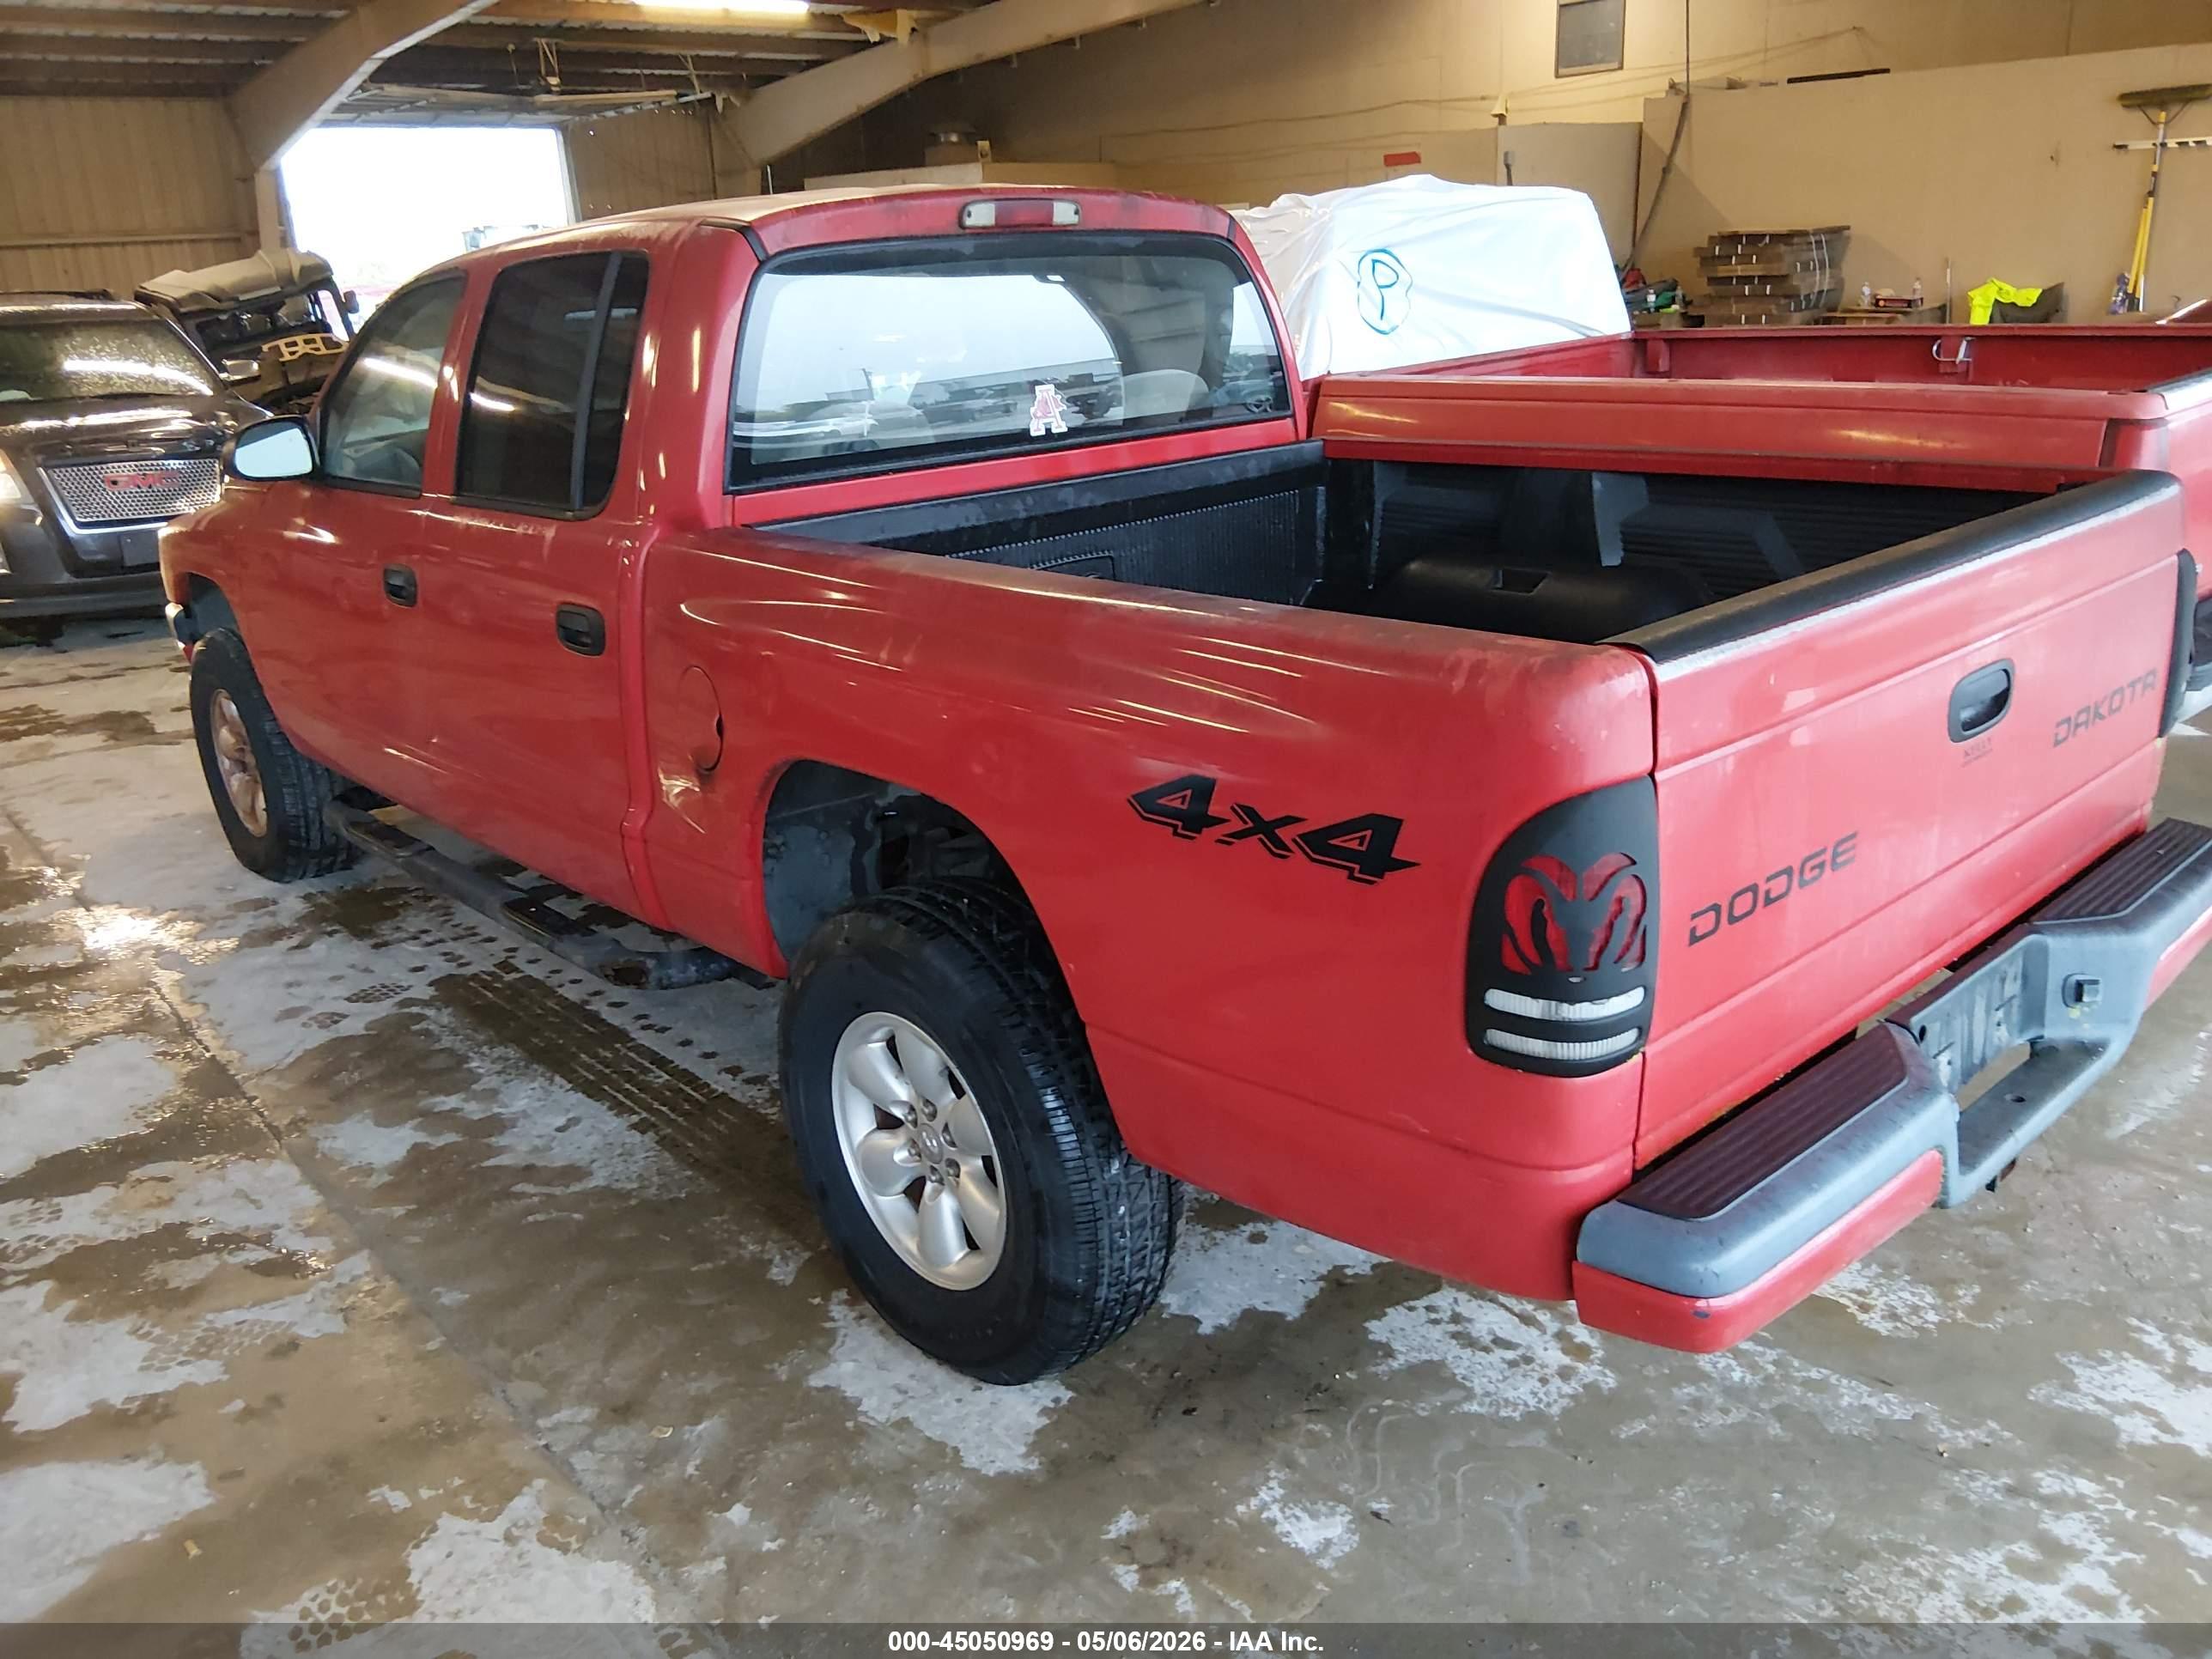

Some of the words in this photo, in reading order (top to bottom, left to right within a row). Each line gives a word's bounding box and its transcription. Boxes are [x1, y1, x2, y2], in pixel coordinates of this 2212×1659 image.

[1371, 258, 1399, 321] P
[104, 471, 180, 492] GMC
[2053, 668, 2158, 747] DAKOTA
[1688, 831, 1858, 947] DODGE
